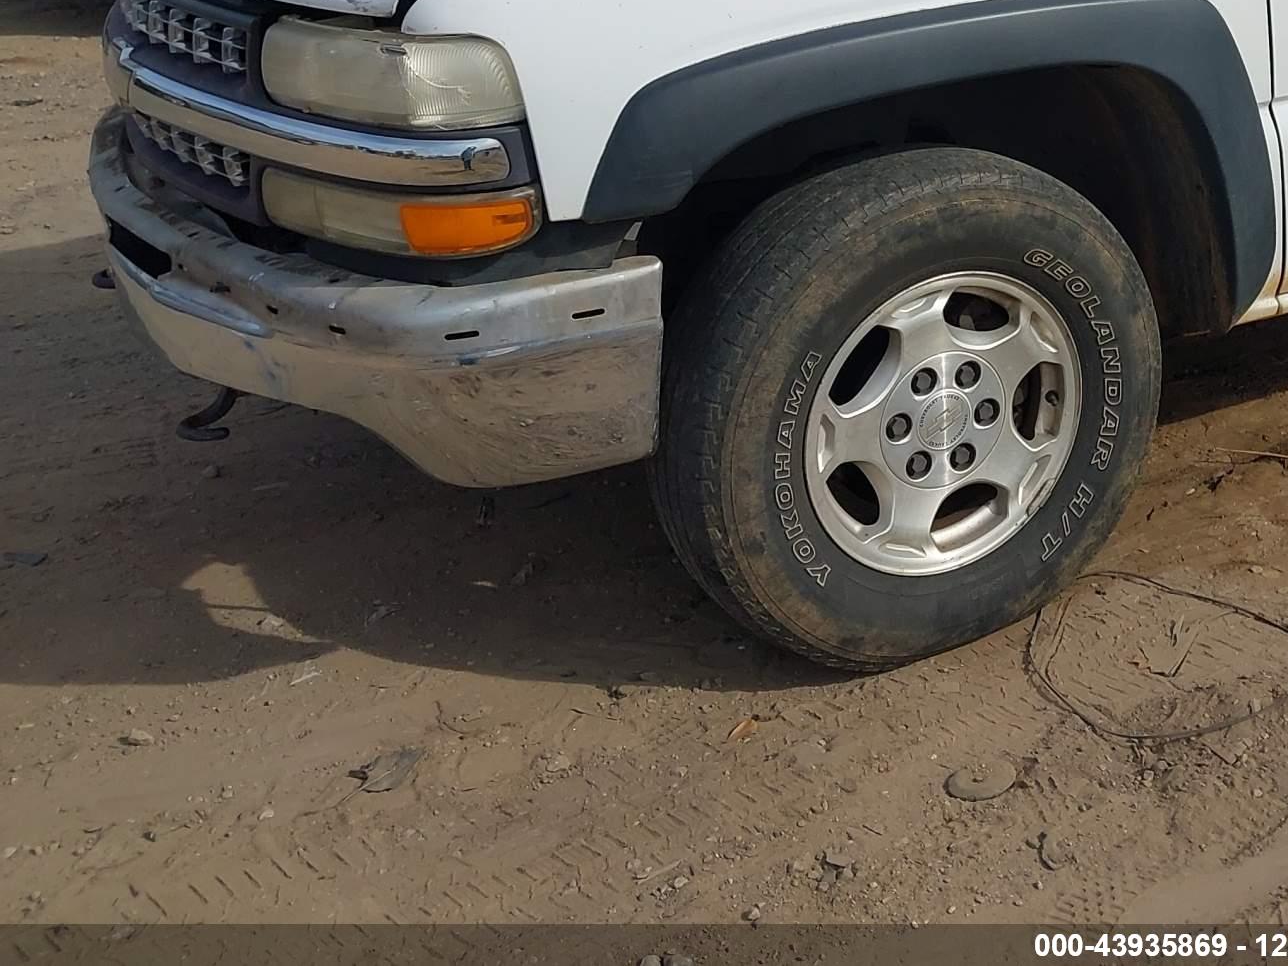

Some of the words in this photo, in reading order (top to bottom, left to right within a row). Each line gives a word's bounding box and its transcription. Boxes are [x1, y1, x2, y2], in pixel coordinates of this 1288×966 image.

[774, 351, 832, 587] YOKOHAMA
[1023, 248, 1122, 471] GEOLANDAR
[1040, 483, 1094, 562] H/T
